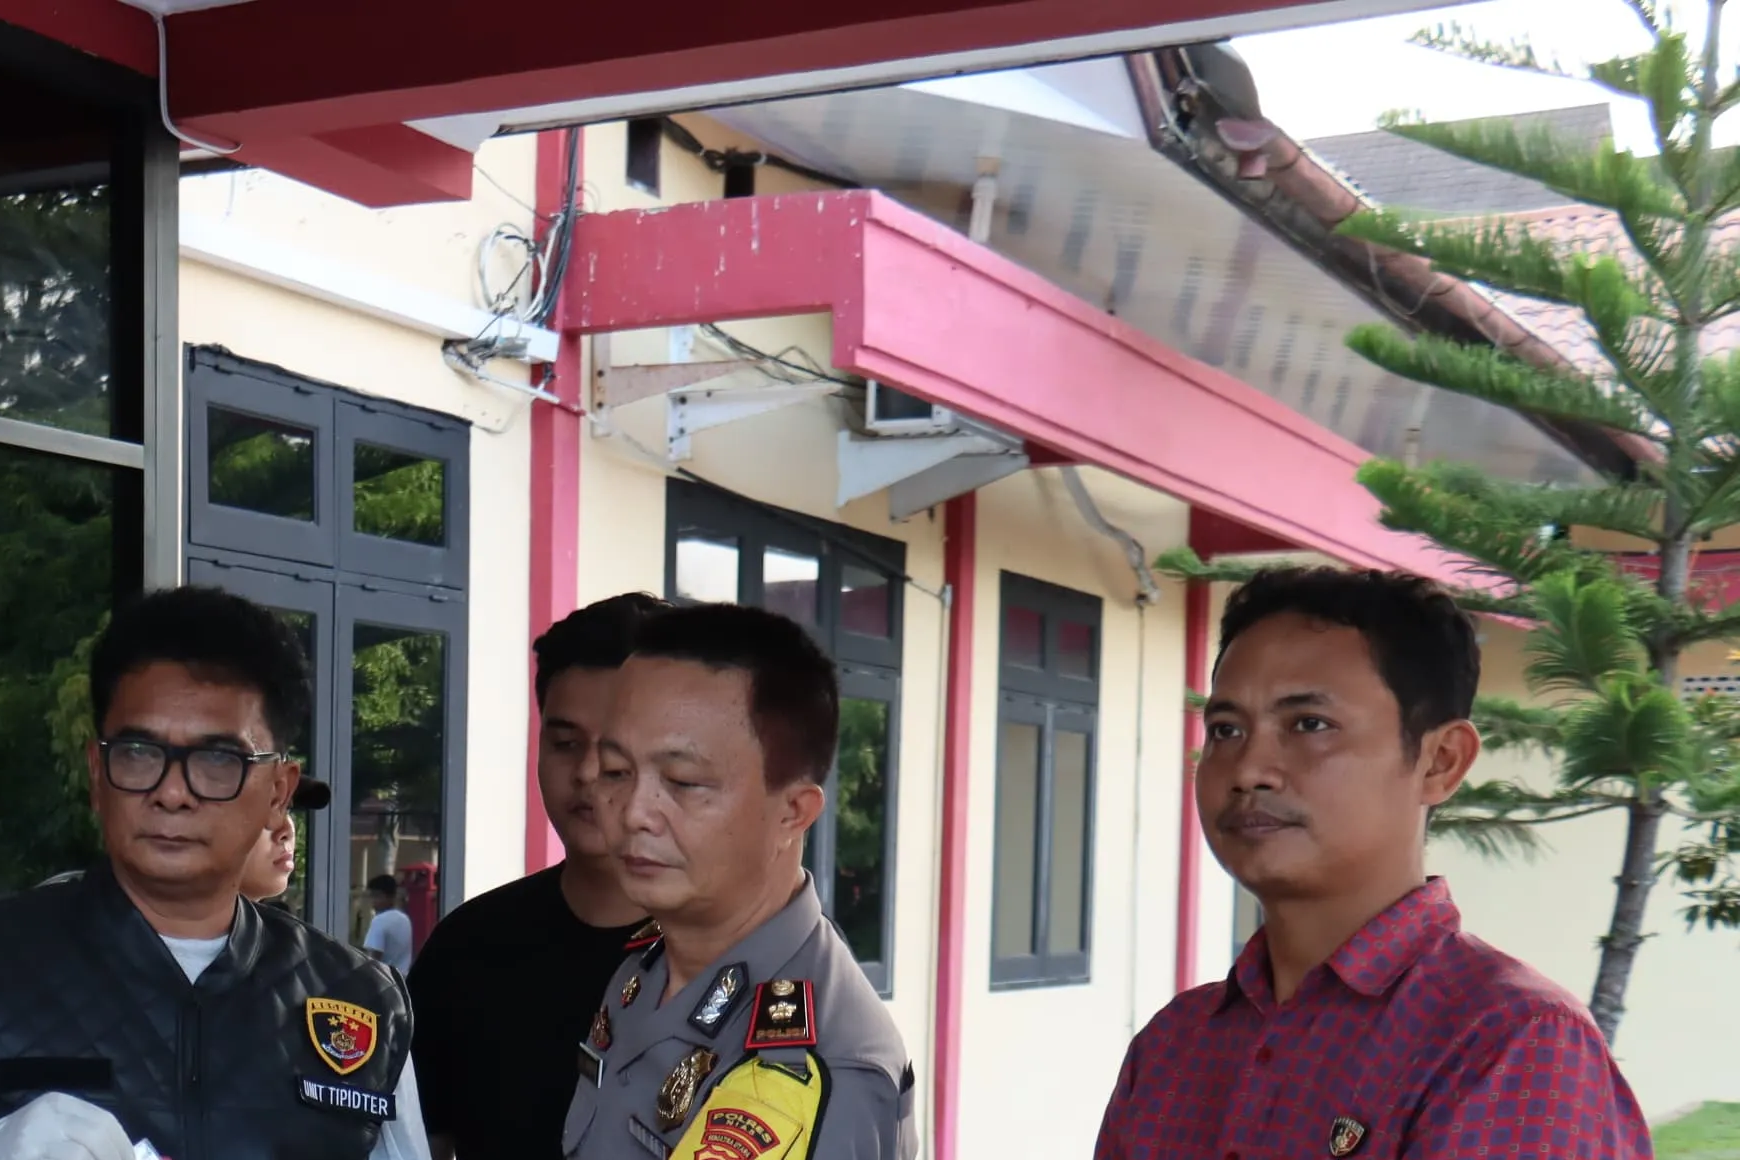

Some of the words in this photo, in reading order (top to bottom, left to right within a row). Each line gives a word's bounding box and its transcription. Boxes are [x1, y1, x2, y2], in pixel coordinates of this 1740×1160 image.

[303, 1079, 326, 1102] UNIT
[327, 1086, 389, 1116] TIPIDTER
[713, 1112, 773, 1144] POLRES
[725, 1119, 755, 1136] NIAS
